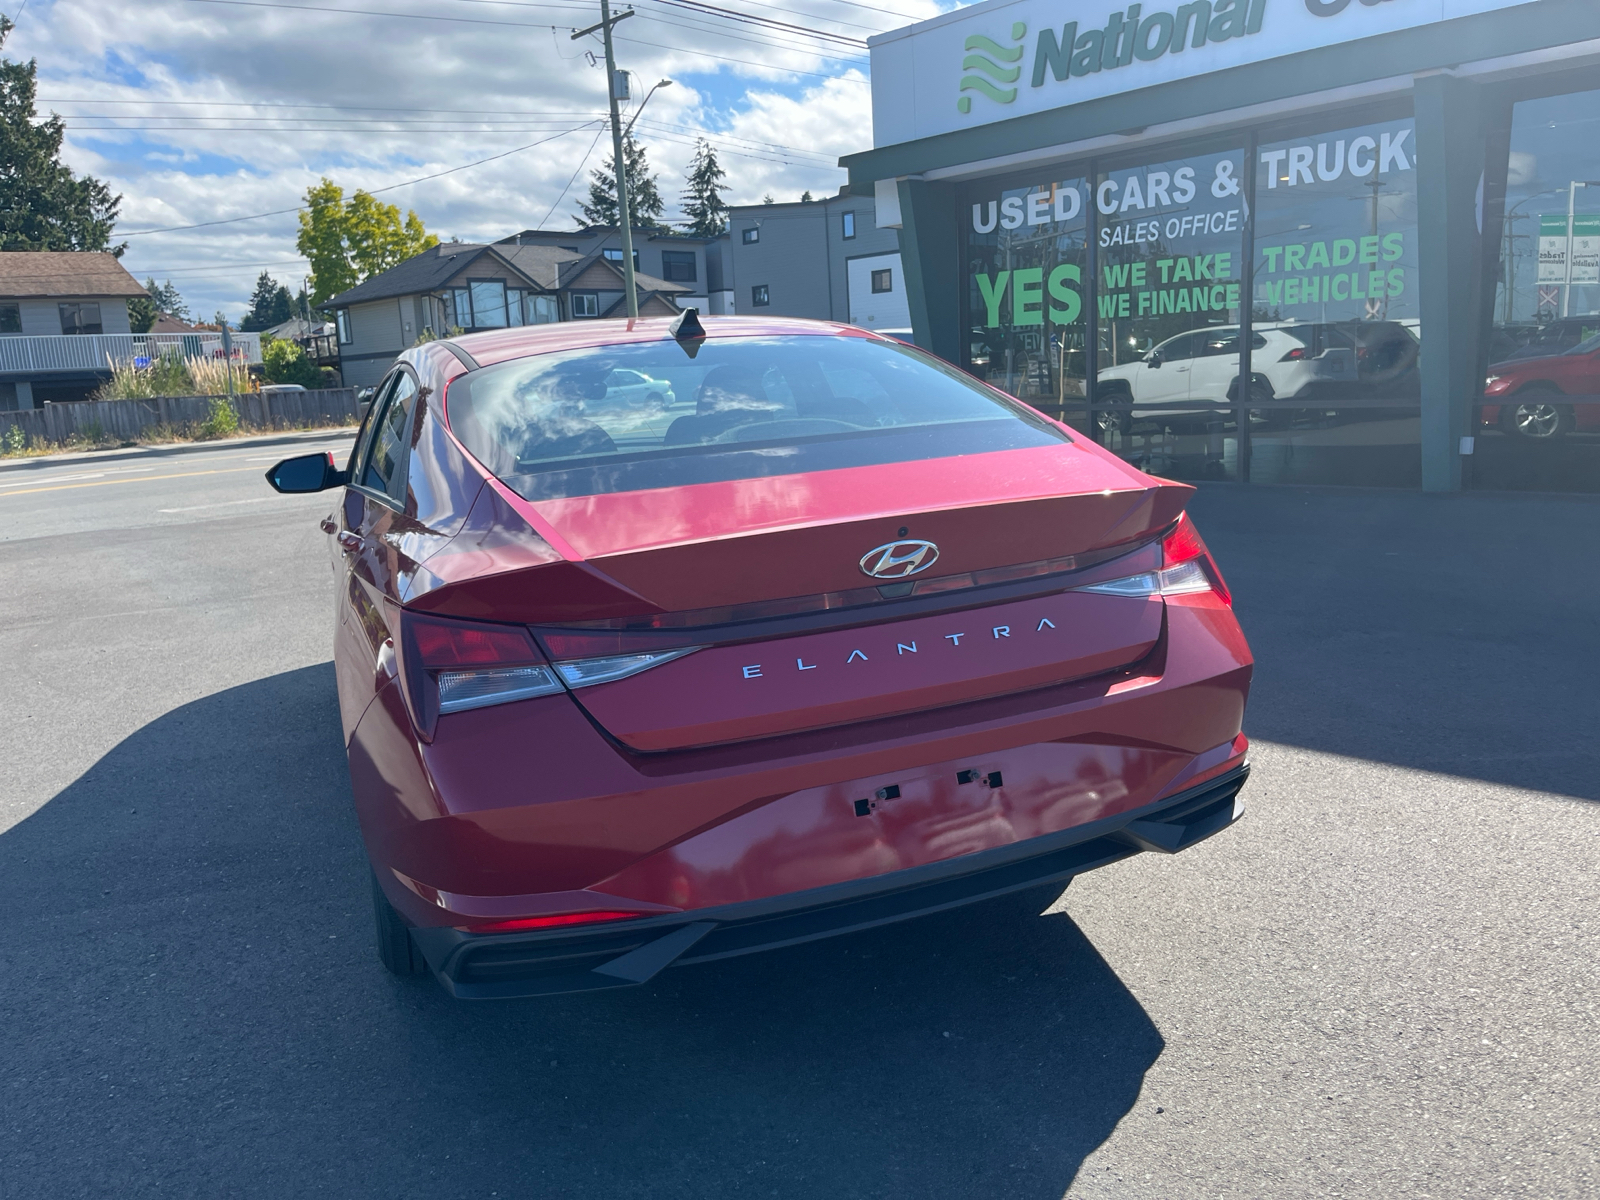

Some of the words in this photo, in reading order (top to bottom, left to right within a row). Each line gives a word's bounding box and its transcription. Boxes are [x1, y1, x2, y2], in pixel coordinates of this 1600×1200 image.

[1031, 0, 1267, 87] National
[972, 187, 1081, 234] USED
[1096, 165, 1196, 215] CARS
[1210, 158, 1240, 199] &
[1260, 128, 1417, 190] TRUCK
[1099, 220, 1159, 248] SALES
[1165, 209, 1239, 239] OFFICE
[1103, 261, 1146, 289] WE
[1156, 252, 1232, 284] TAKE
[1262, 232, 1404, 274] TRADES
[975, 263, 1082, 329] YES
[1097, 292, 1130, 319] WE
[1138, 283, 1240, 316] FINANCE
[1265, 267, 1405, 307] VEHICLES
[742, 617, 1056, 679] ELANTRA
